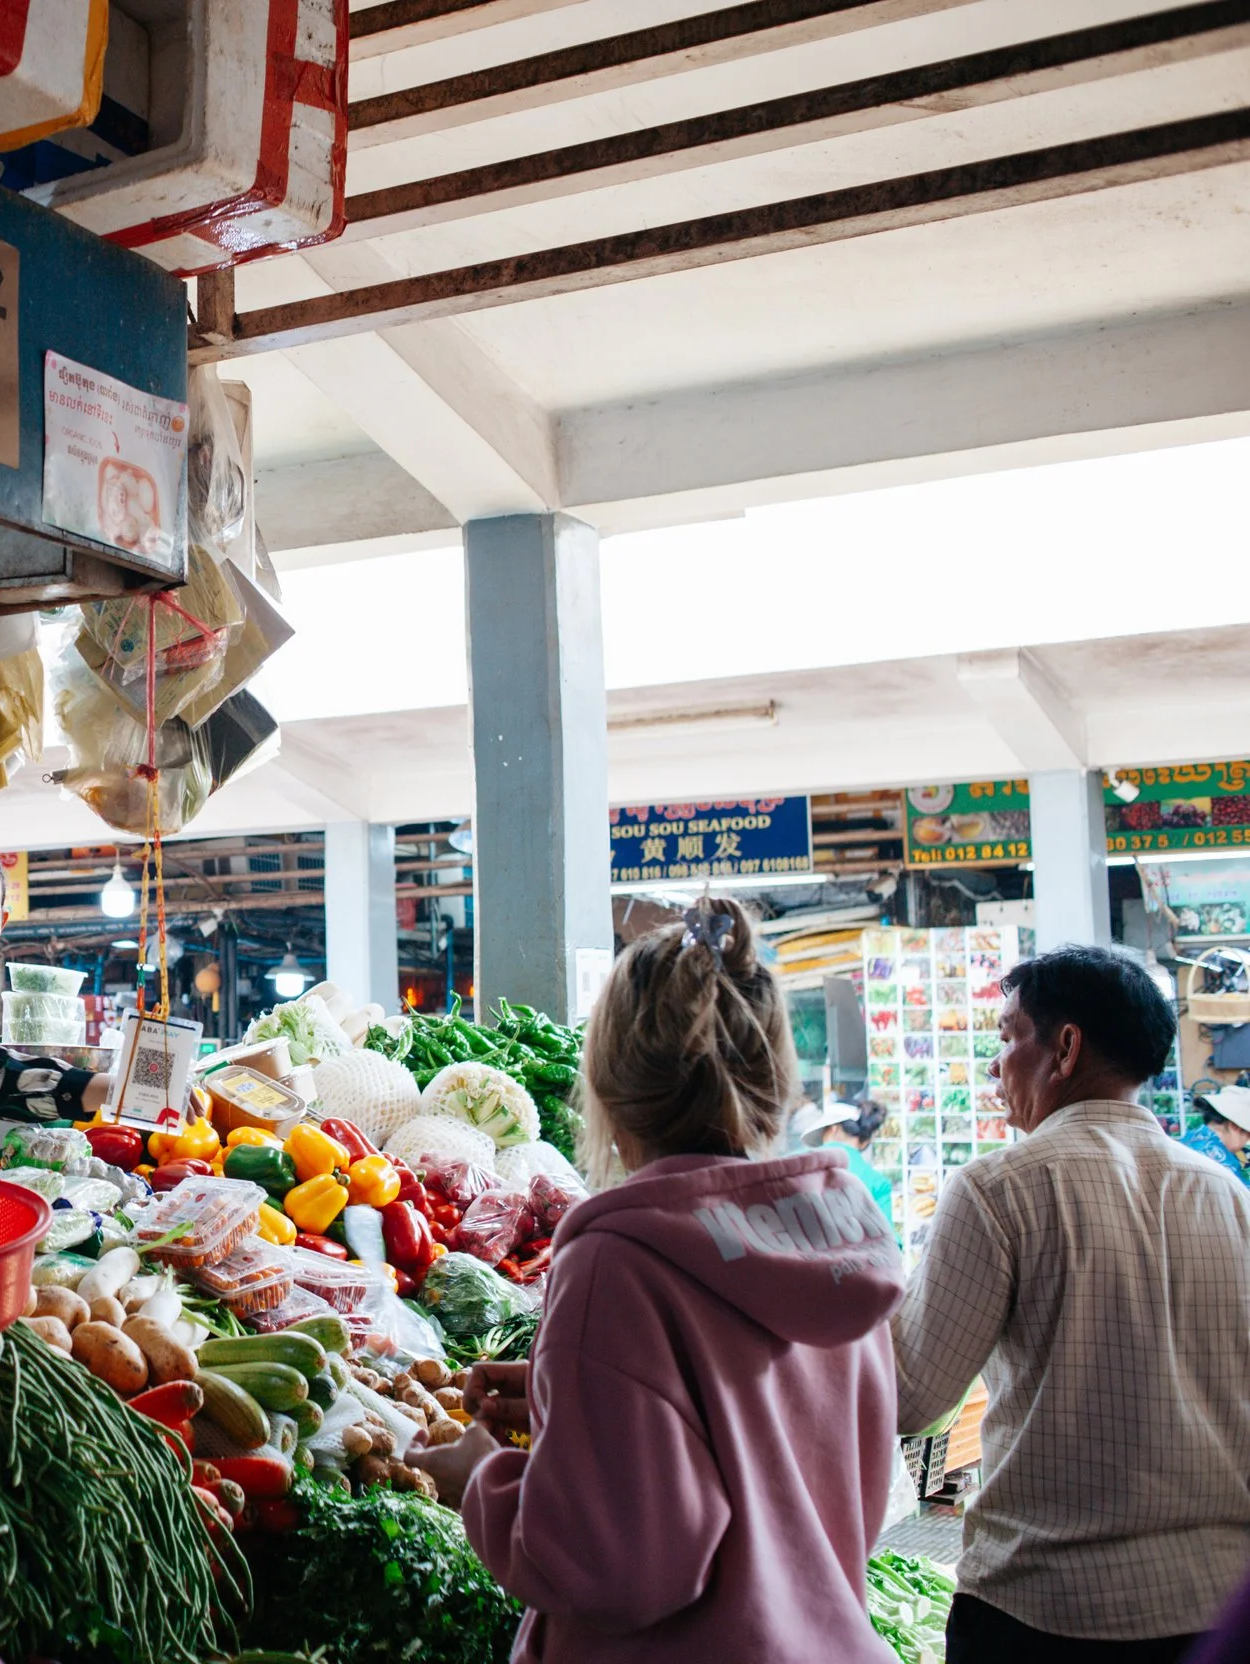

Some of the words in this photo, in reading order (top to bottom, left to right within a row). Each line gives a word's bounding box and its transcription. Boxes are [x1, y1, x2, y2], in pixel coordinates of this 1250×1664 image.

[611, 823, 646, 840] SOU
[649, 820, 684, 838] SOU
[688, 814, 772, 834] SEAFOOD
[1193, 830, 1228, 846] 012
